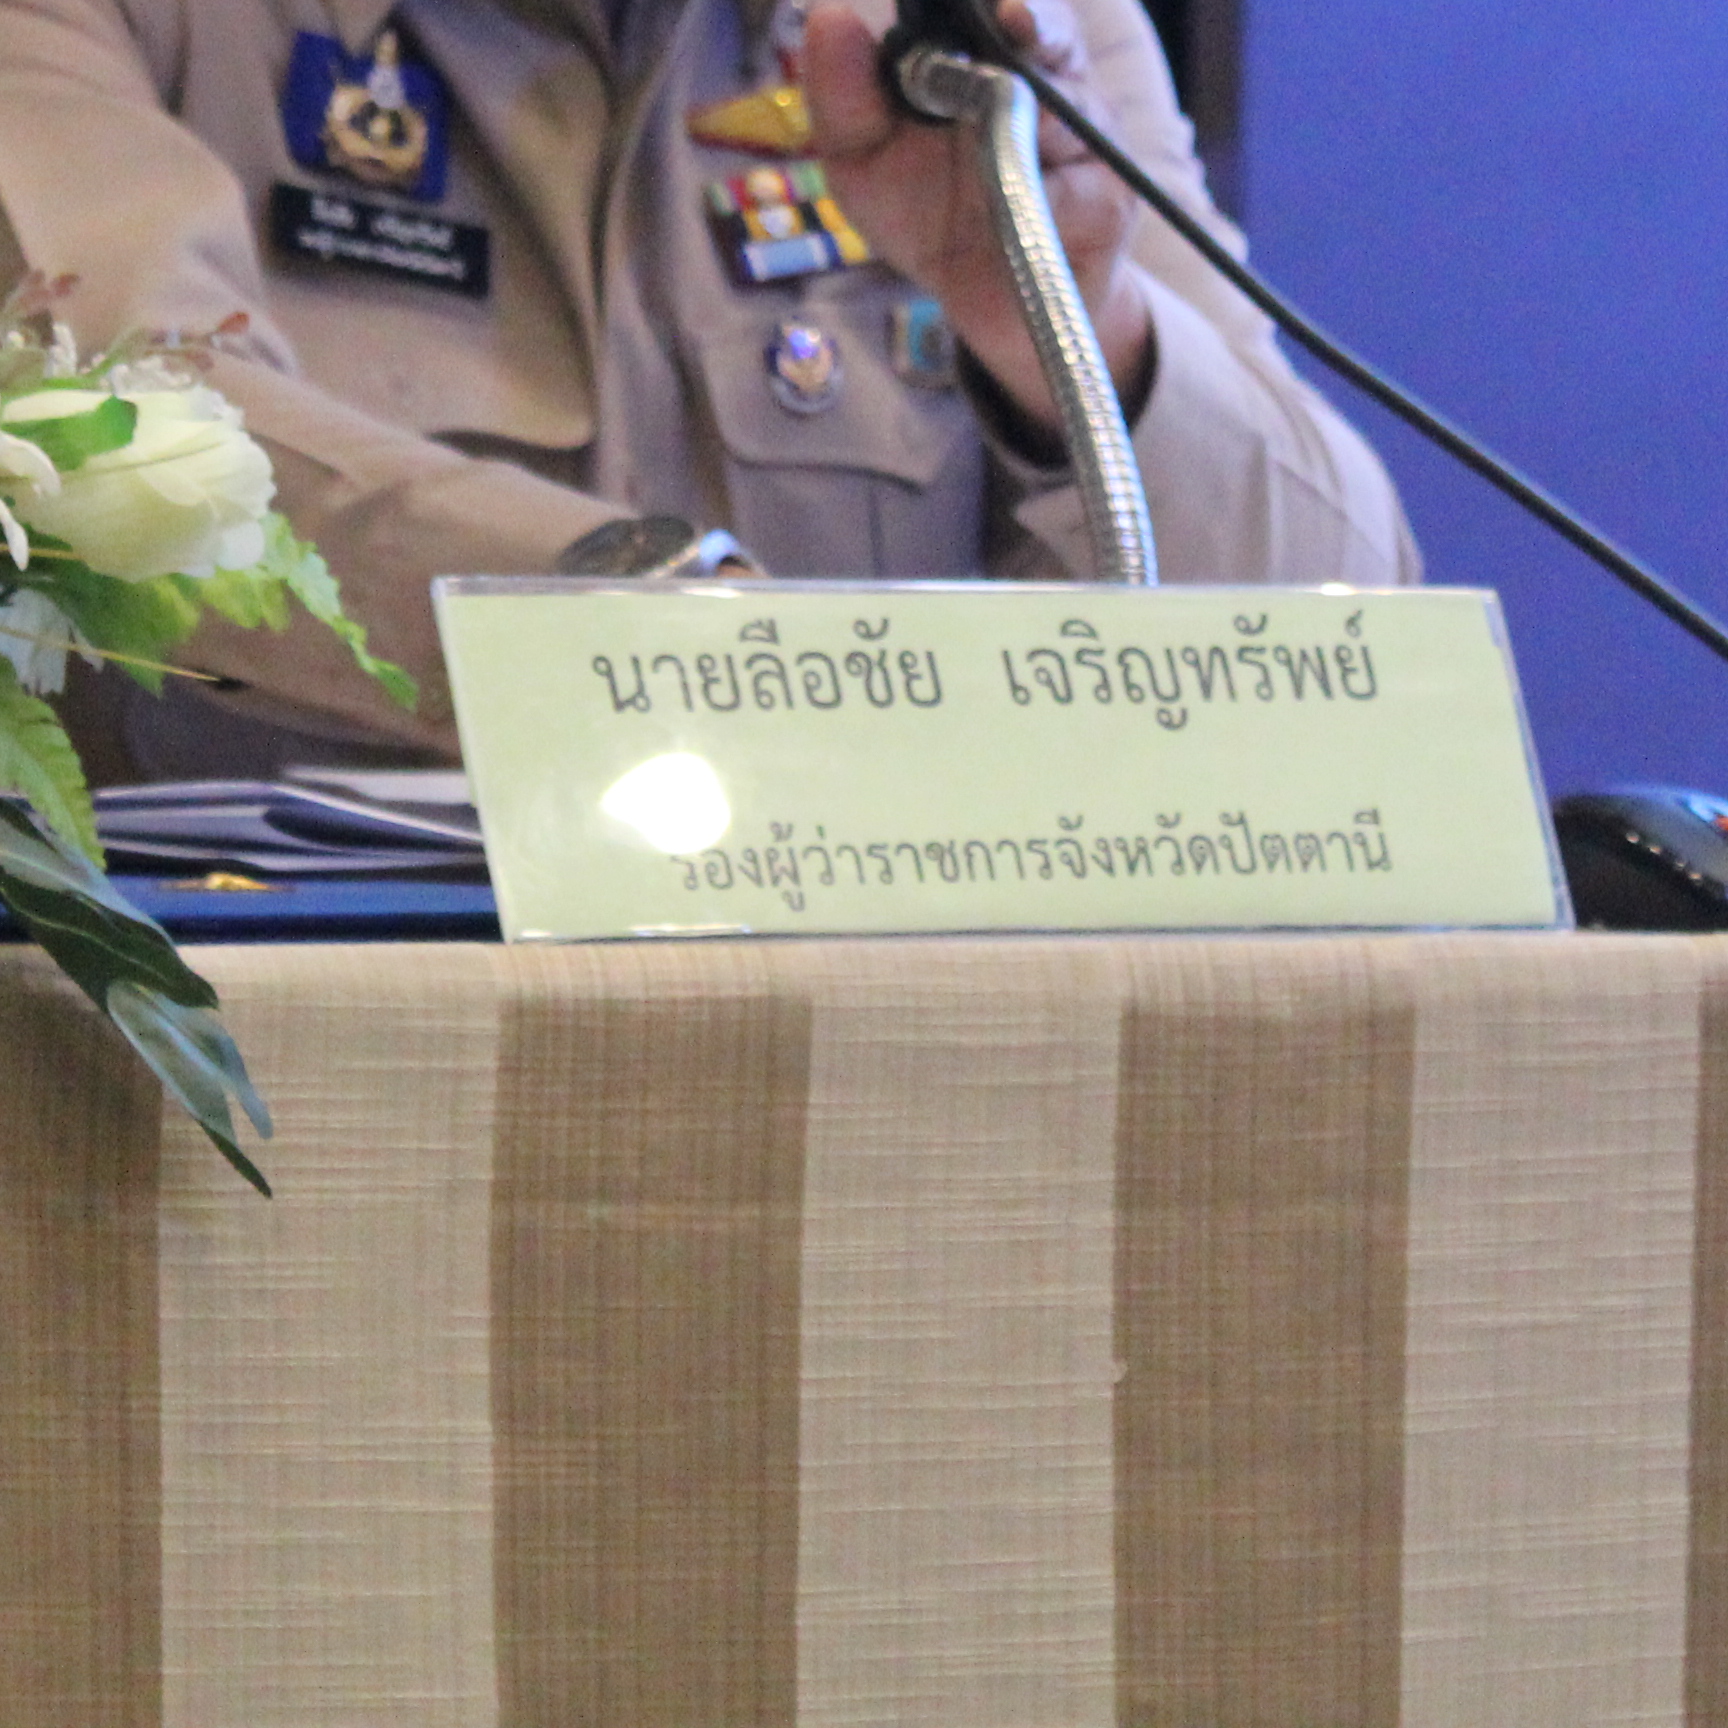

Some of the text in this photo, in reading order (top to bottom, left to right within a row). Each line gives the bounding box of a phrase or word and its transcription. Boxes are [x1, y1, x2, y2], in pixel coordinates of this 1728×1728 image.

[591, 609, 1379, 731] นายลือชัย เจริญทรัพย์
[670, 807, 1393, 912] รองผู้ว่าราชการจังหวัดปัตตานี
